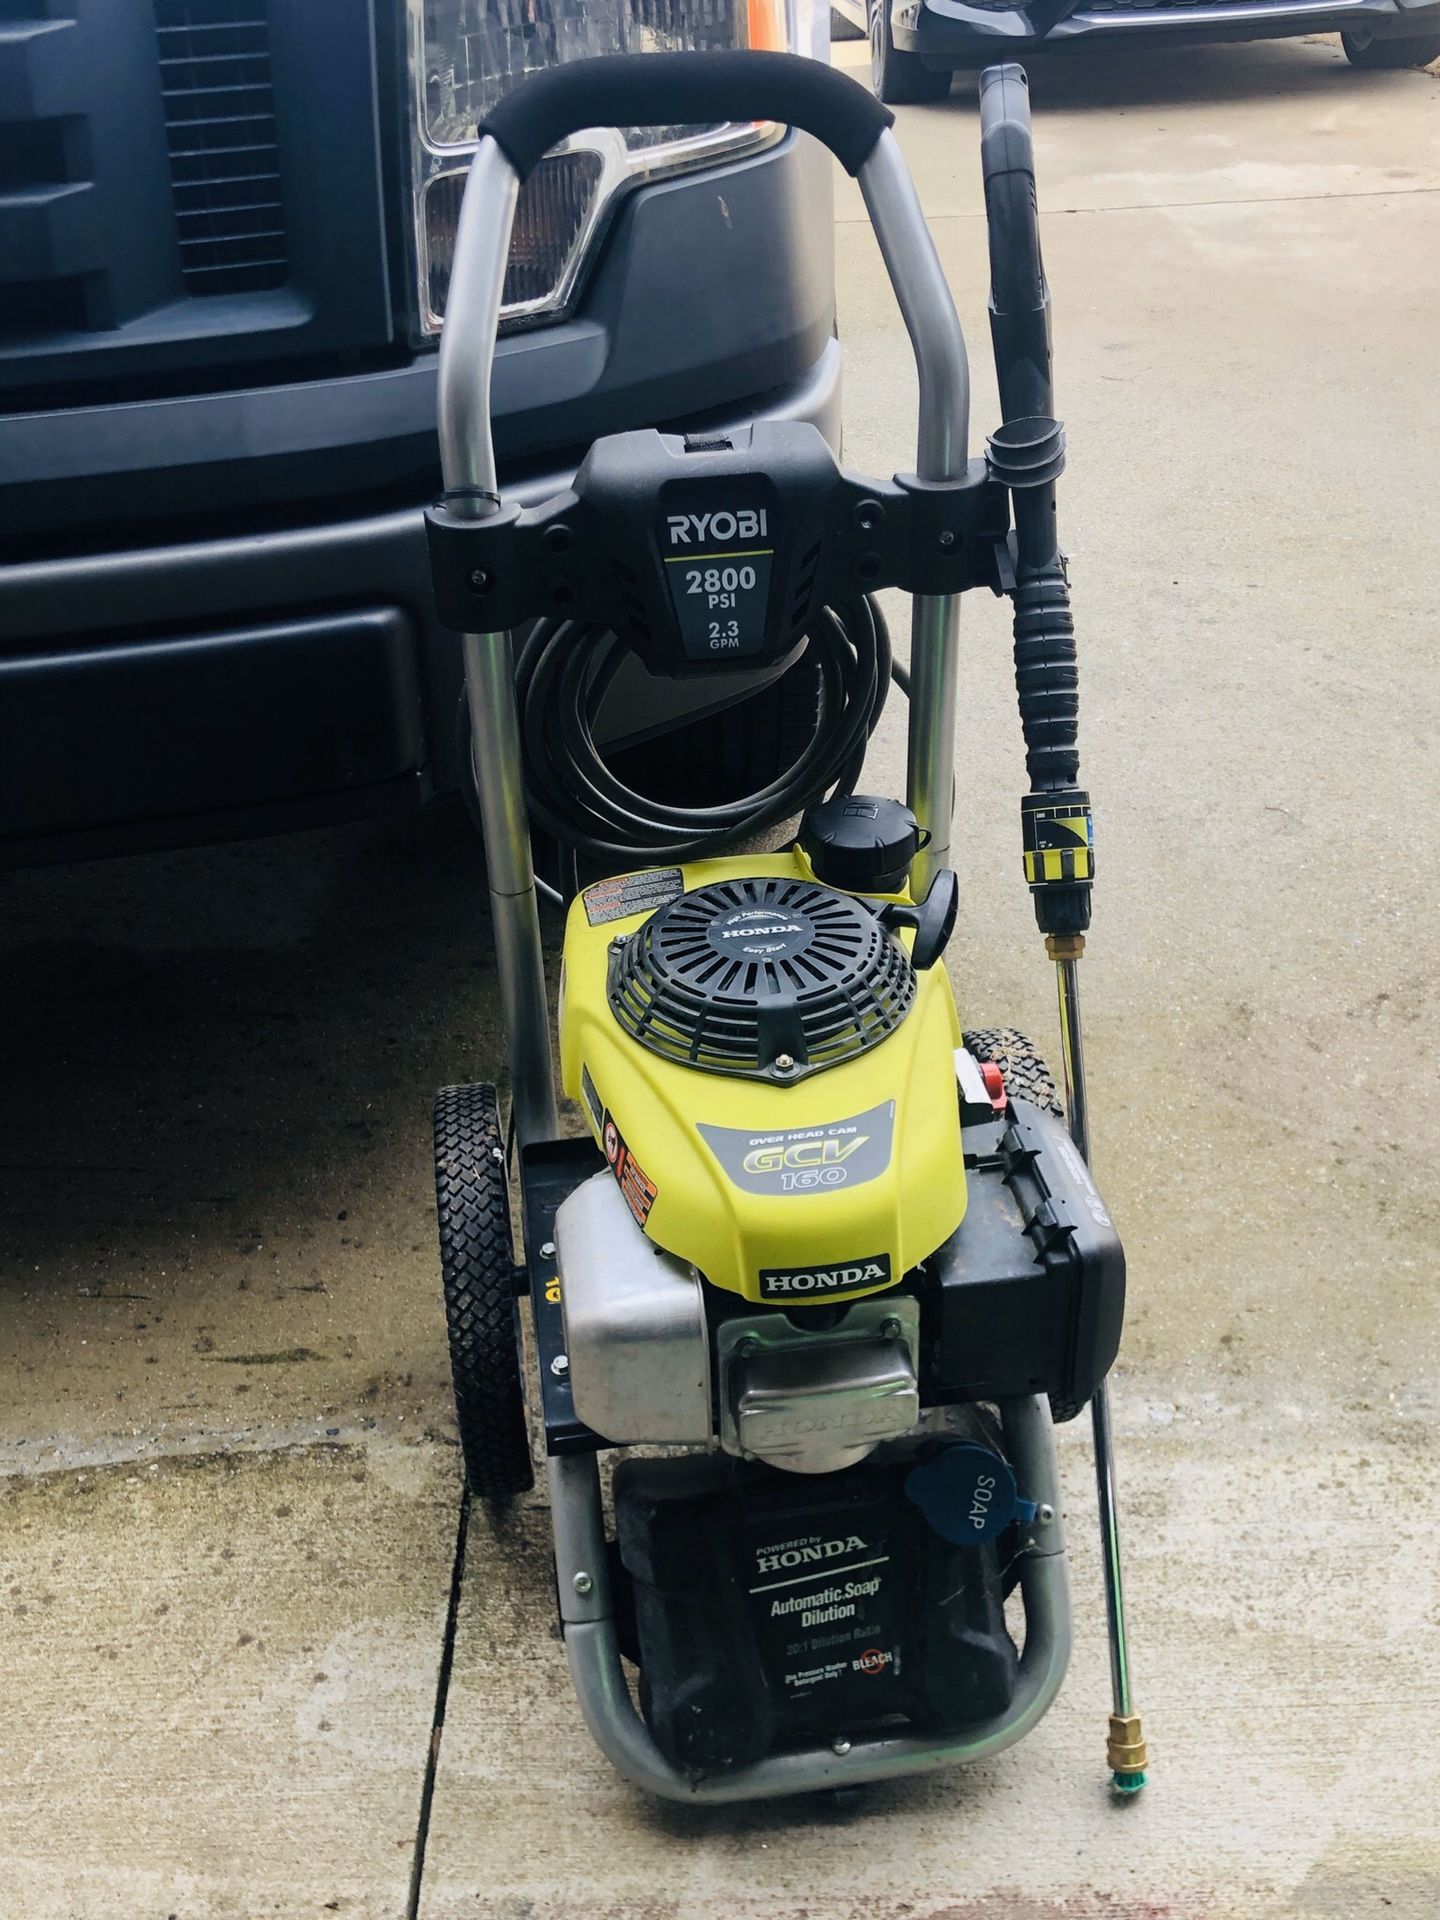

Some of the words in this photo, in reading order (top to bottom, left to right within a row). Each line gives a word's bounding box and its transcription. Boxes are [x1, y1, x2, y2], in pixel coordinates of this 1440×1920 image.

[667, 509, 767, 544] RYOBI
[685, 566, 756, 594] 2800
[708, 593, 736, 609] PSI
[708, 620, 739, 638] 2.3
[709, 638, 740, 649] GPM
[721, 925, 803, 939] HONDA
[742, 946, 765, 955] Easy
[766, 943, 787, 953] Start
[749, 1135, 785, 1146] OVER
[787, 1130, 824, 1141] HEAD
[828, 1126, 858, 1137] CAM
[743, 1136, 871, 1175] GCV
[781, 1166, 848, 1191] 160
[765, 1263, 887, 1292] HONDA
[968, 1475, 996, 1530] SOAP
[756, 1538, 807, 1556] POWERED
[809, 1536, 822, 1545] by
[757, 1536, 869, 1573] HONDA
[771, 1587, 842, 1617] Automatic
[845, 1579, 880, 1599] Soap
[802, 1603, 856, 1628] Dilution
[852, 1651, 893, 1671] BLEACH
